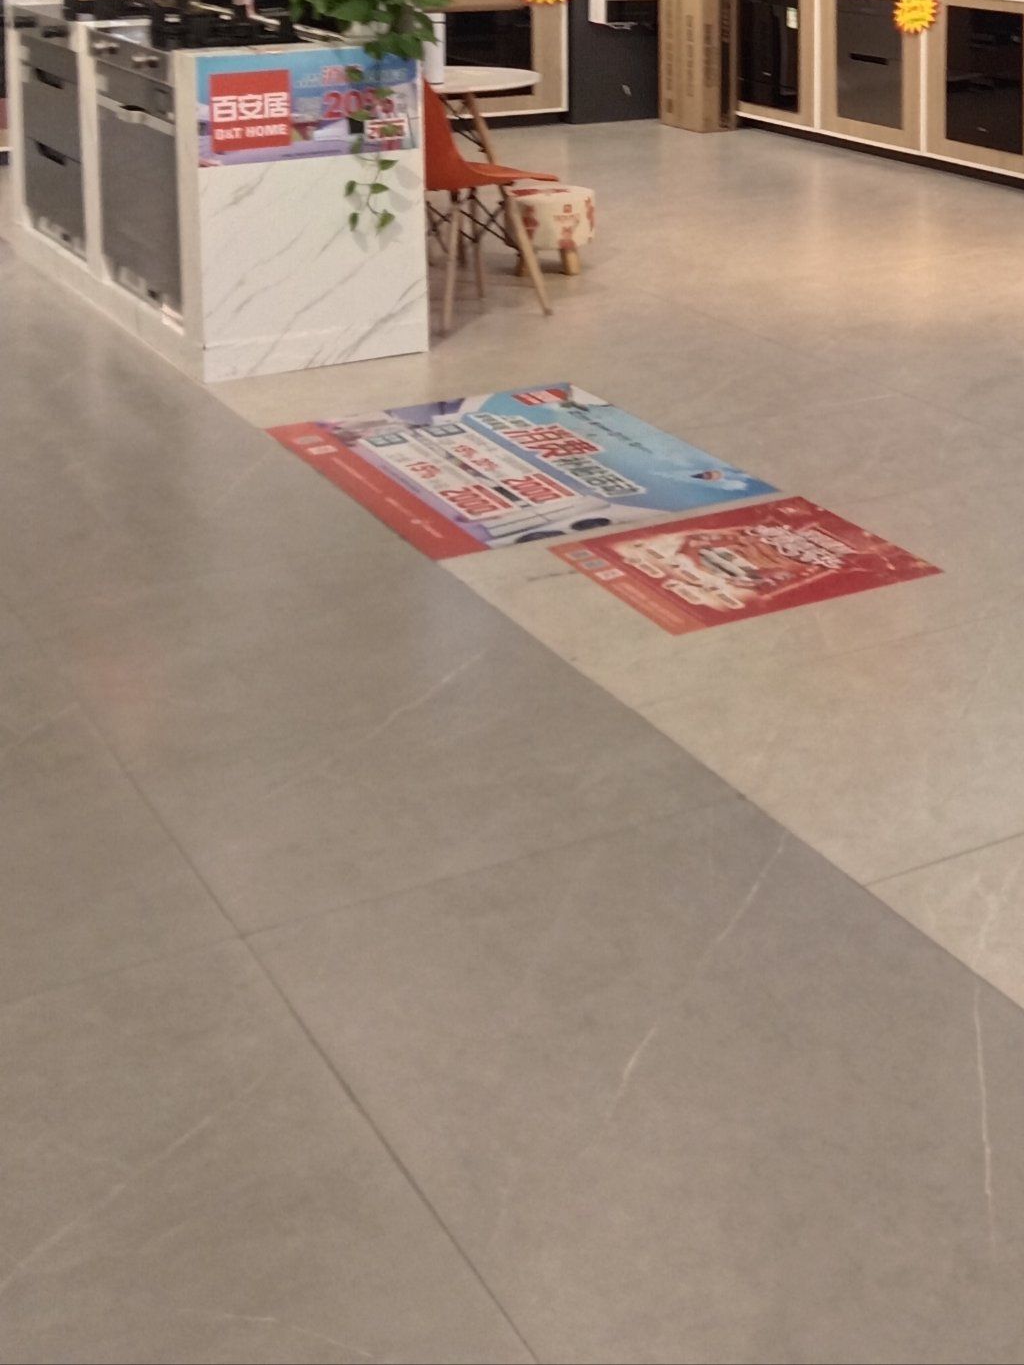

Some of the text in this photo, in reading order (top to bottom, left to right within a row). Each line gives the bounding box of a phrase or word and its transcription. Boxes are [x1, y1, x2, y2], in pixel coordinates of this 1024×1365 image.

[211, 91, 291, 123] 百安居
[245, 123, 289, 139] HOME
